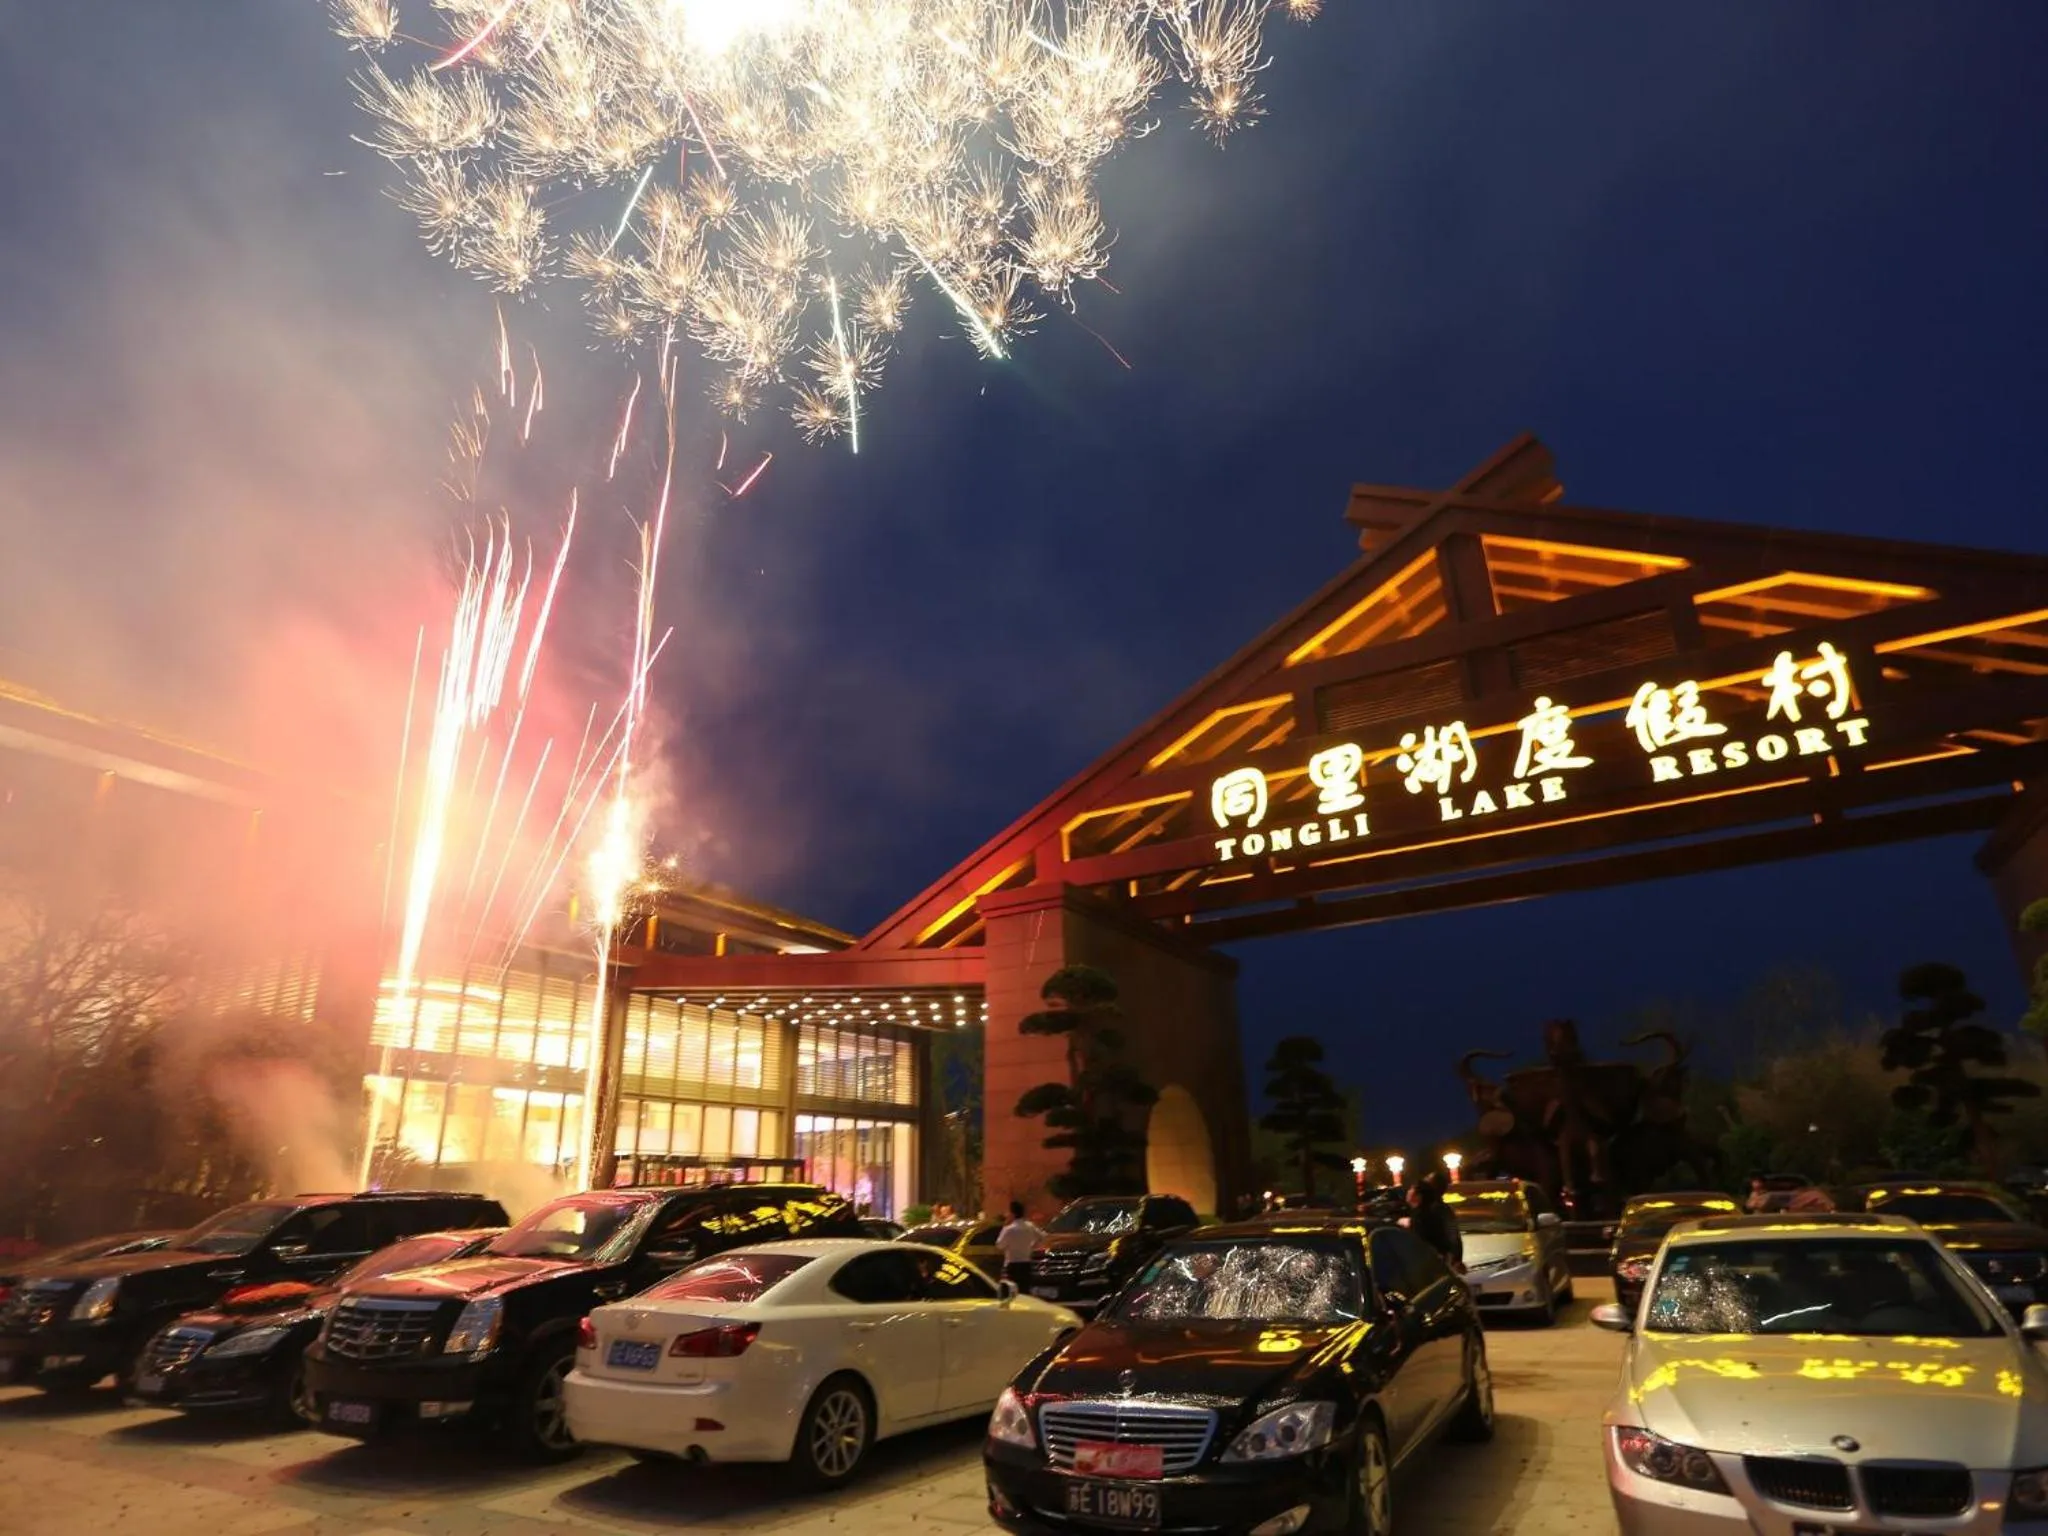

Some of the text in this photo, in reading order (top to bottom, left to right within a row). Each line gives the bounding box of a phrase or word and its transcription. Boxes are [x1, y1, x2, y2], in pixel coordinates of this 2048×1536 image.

[1210, 641, 1853, 830] 同里湖度假村
[1214, 718, 1870, 861] TONGLI LAKE RESORT
